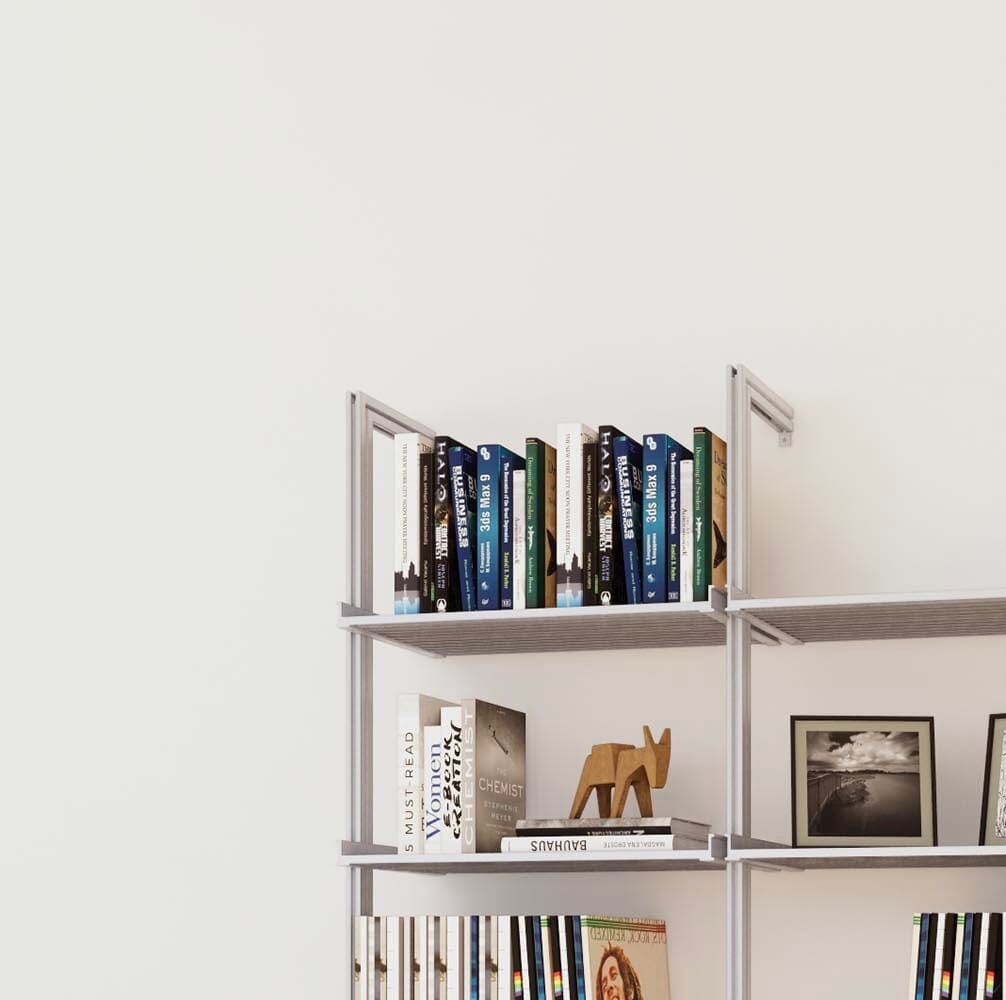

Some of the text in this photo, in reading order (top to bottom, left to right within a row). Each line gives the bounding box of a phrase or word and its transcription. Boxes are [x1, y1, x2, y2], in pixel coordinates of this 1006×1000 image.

[437, 442, 447, 502] HALO
[600, 431, 611, 492] HALO
[646, 464, 657, 472] 9
[646, 475, 657, 499] Max
[455, 465, 469, 548] BUSINESS
[480, 485, 490, 509] Max
[480, 511, 490, 532] 3ds
[620, 455, 634, 540] BUSINESS
[646, 502, 657, 523] 3ds
[405, 731, 414, 852] 5 MUST-READ
[425, 743, 441, 840] Women
[443, 732, 452, 828] E-BOOK
[450, 720, 462, 839] CREATION
[465, 707, 474, 845] CHEMIST
[478, 777, 523, 798] CHEMIST
[531, 840, 587, 851] BAUHAUS
[603, 841, 665, 849] MAGDALENA DROSTE
